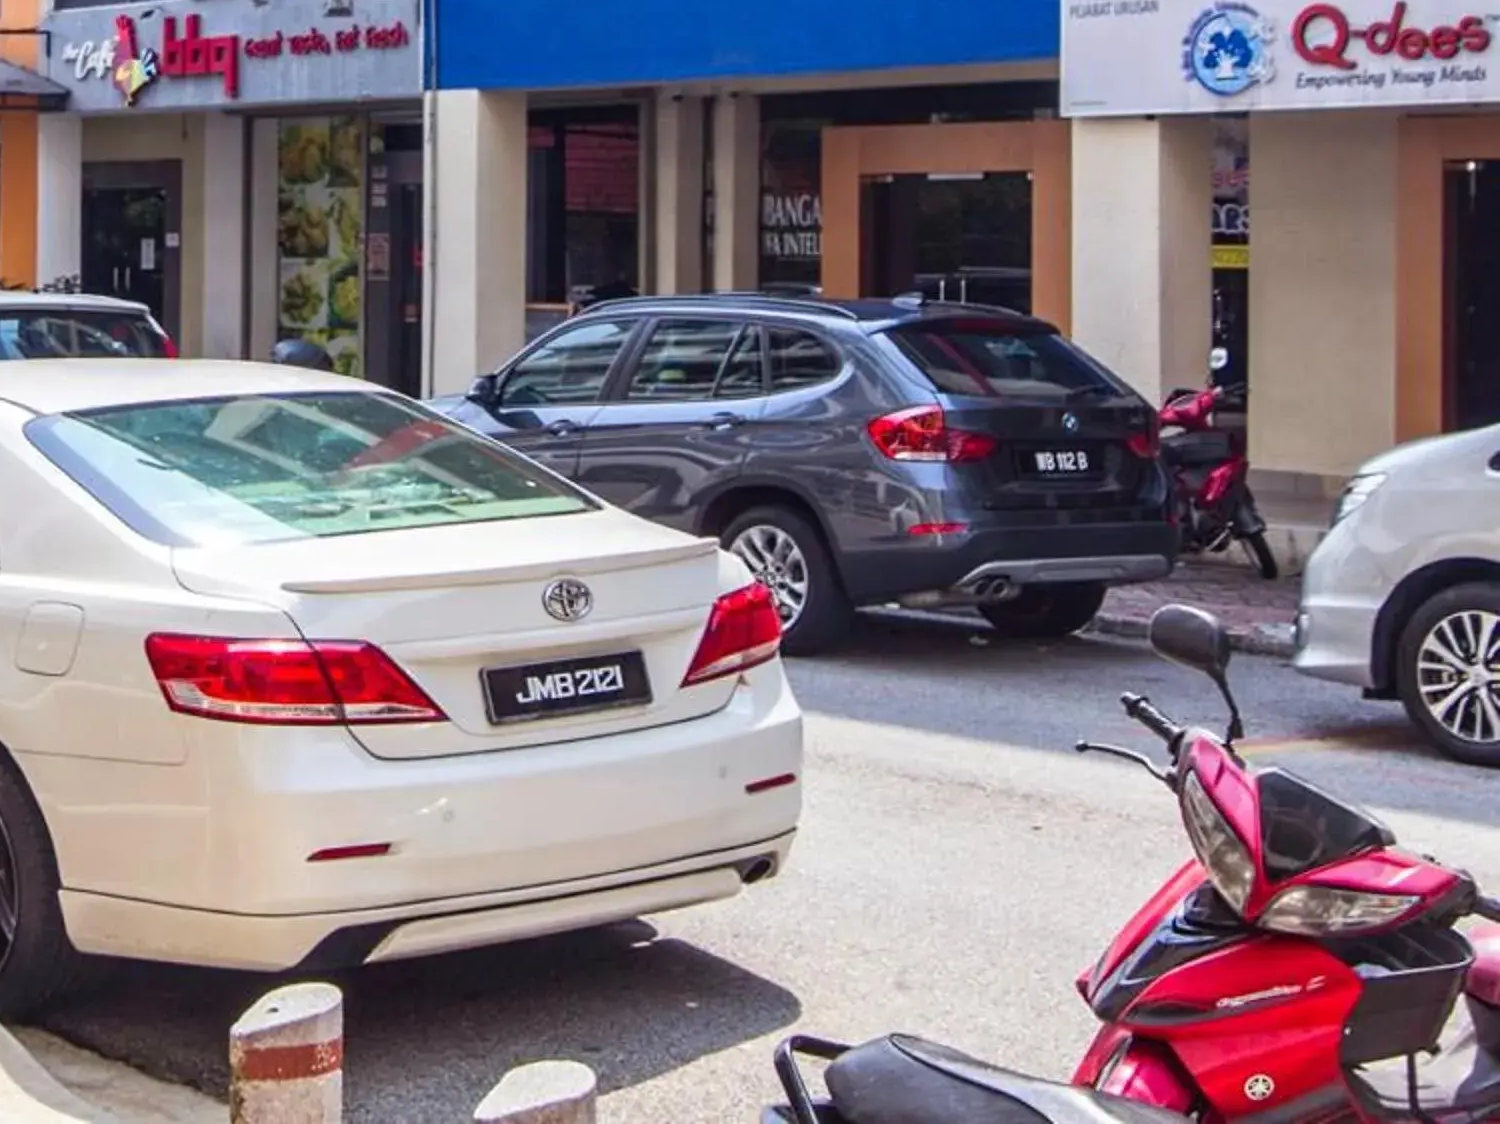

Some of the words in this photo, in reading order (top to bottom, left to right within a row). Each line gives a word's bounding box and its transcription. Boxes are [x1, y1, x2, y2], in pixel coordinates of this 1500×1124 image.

[163, 13, 239, 99] bbq
[1292, 0, 1492, 71] Q-dees
[1295, 68, 1386, 90] Empowering
[1391, 65, 1436, 87] Young
[1439, 64, 1487, 83] Minds
